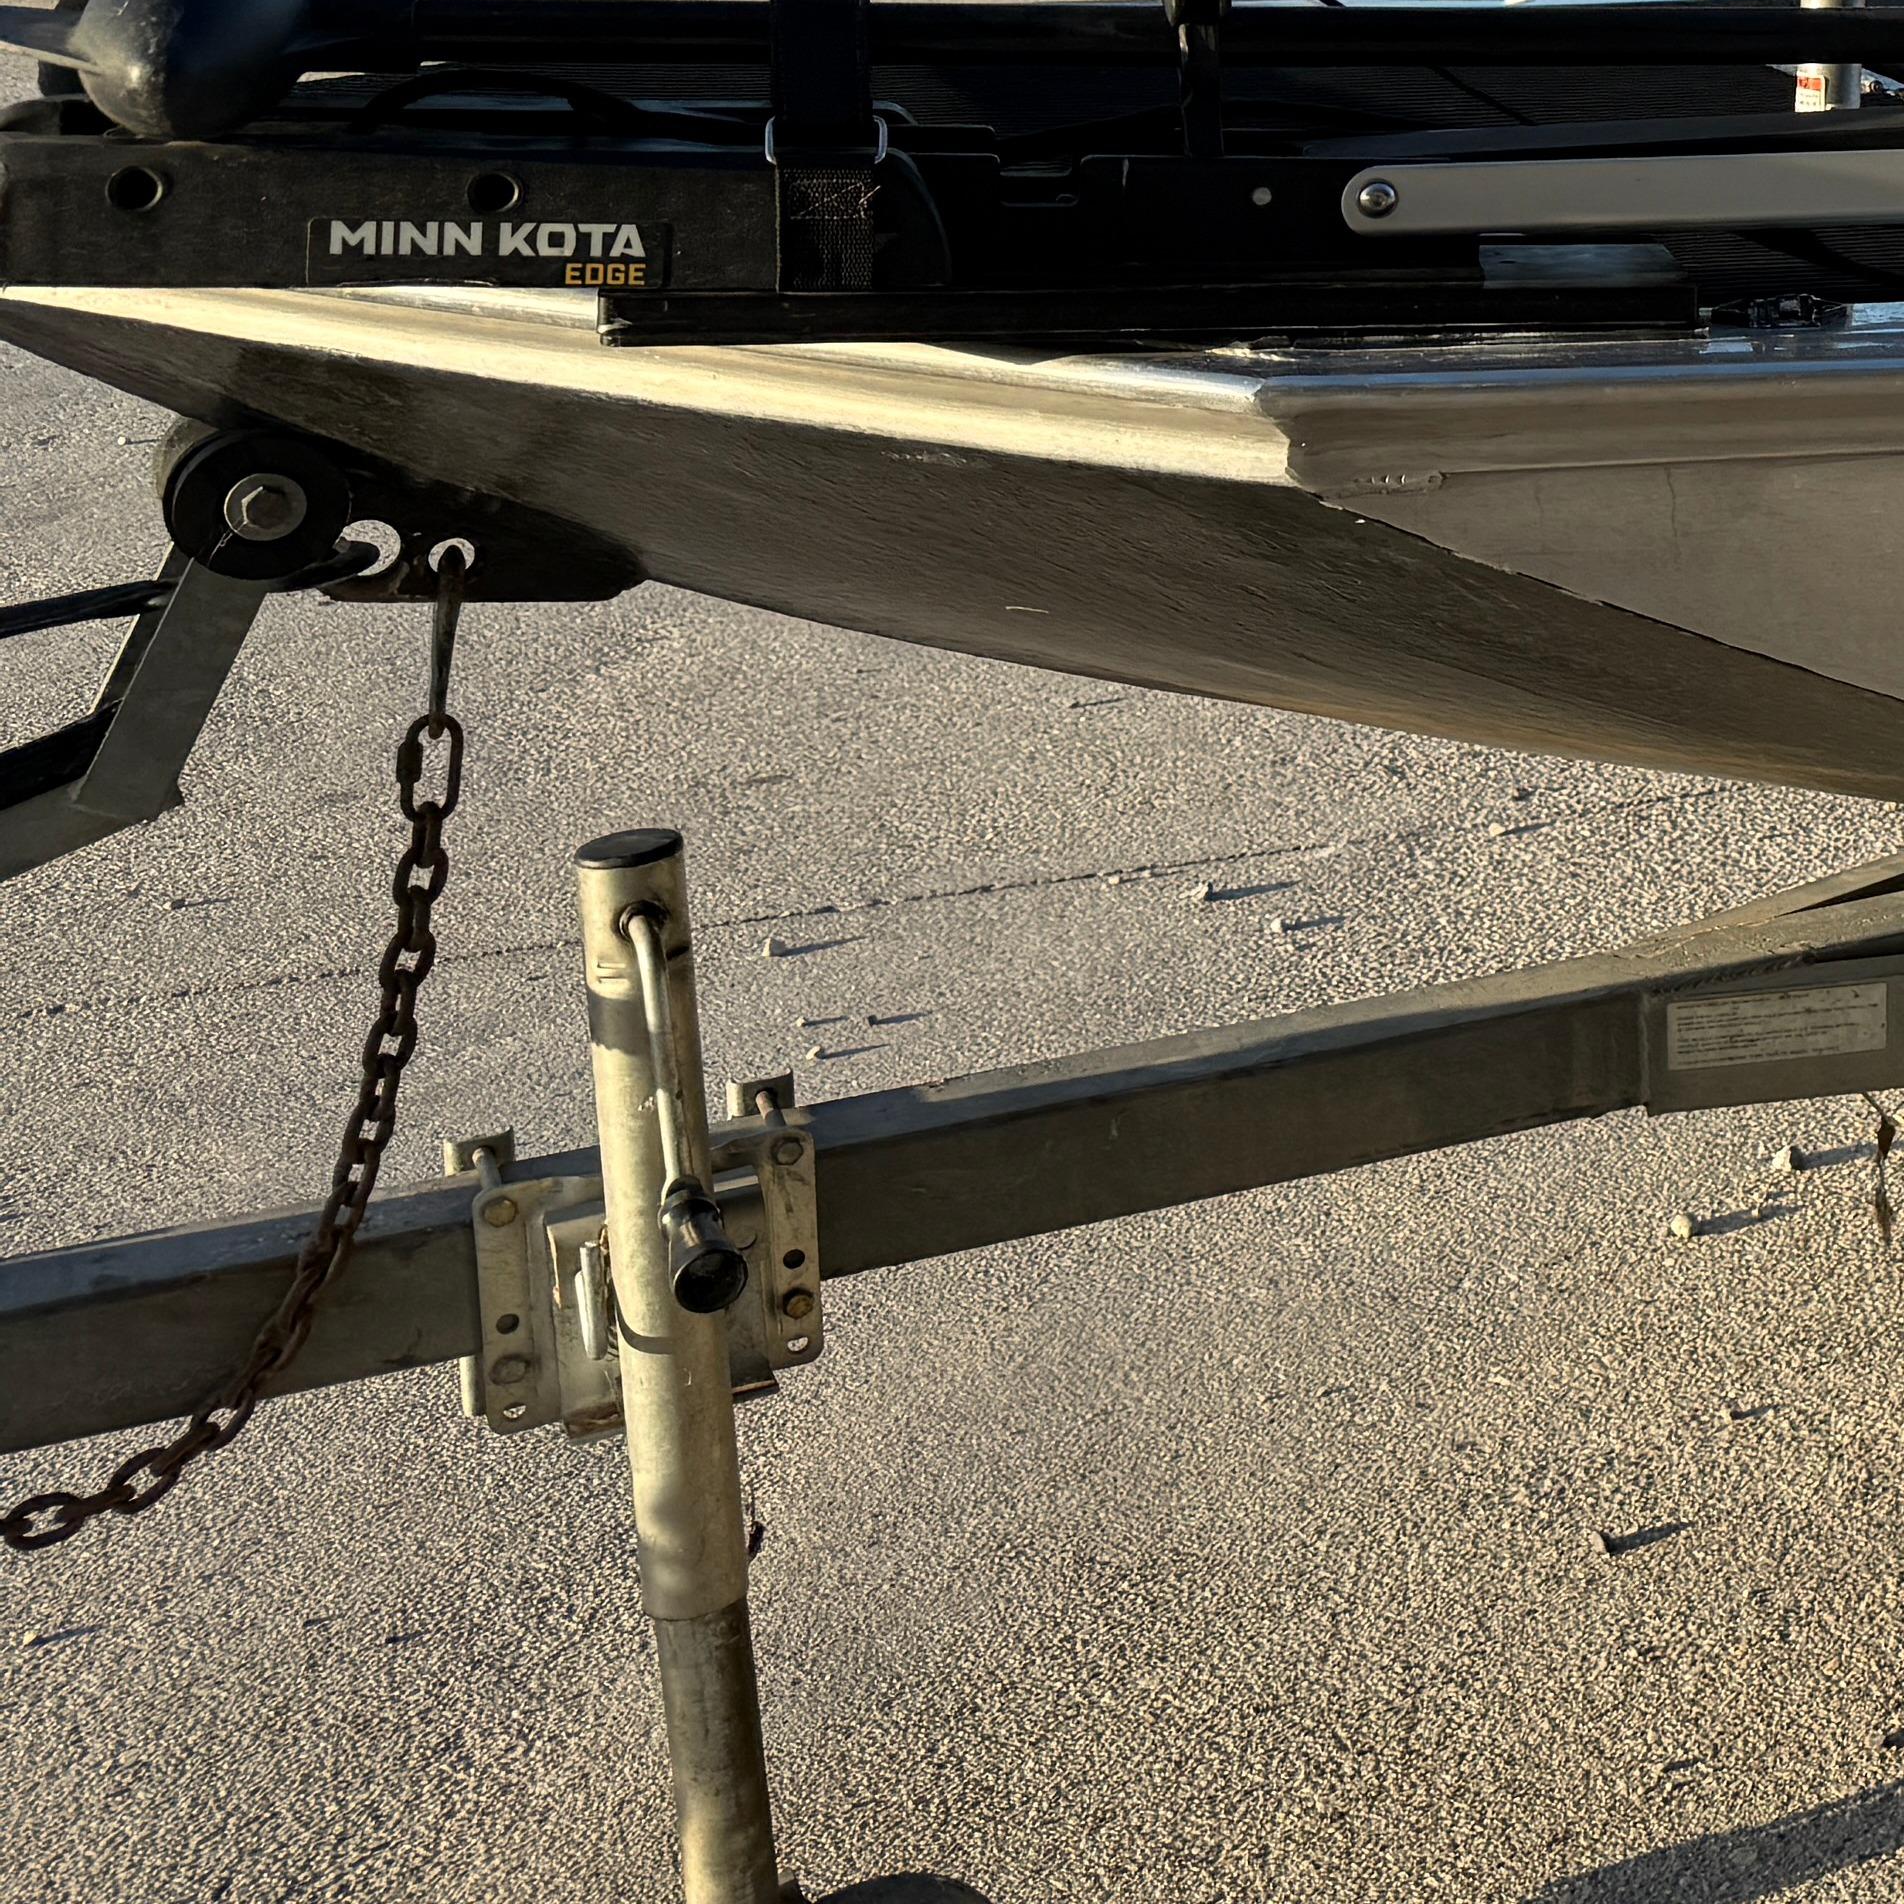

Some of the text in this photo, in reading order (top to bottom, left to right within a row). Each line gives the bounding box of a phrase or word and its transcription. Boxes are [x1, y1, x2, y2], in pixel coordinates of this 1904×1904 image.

[329, 220, 647, 258] MINN KOTA
[564, 262, 647, 286] EDGE
